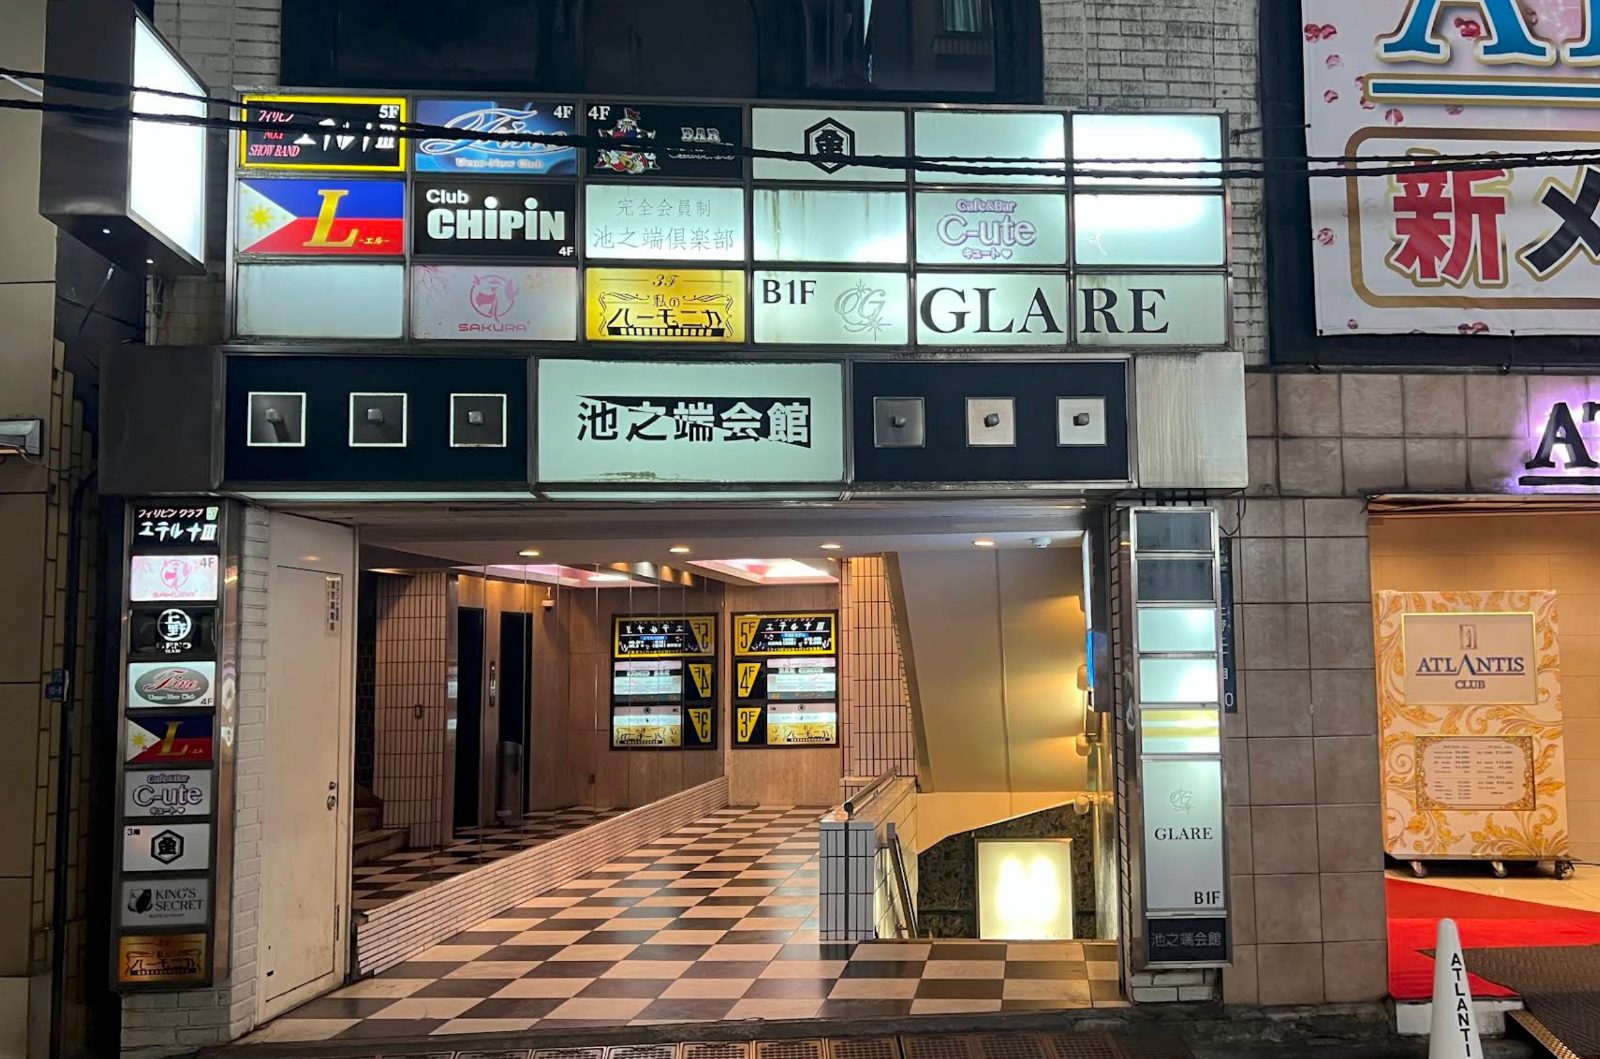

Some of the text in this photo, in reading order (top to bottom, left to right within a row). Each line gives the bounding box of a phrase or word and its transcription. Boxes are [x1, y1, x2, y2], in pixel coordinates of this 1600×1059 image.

[379, 105, 400, 119] 5F
[553, 105, 574, 119] 4F
[588, 106, 611, 121] 4F
[249, 144, 301, 157] SHOW BAND
[426, 189, 469, 204] Club
[616, 198, 711, 217] 完全会員制
[302, 189, 359, 248] L
[937, 214, 1036, 246] C-ute
[558, 246, 574, 257] 4F
[762, 279, 817, 305] B1F
[653, 294, 681, 308] 私の
[920, 286, 1169, 334] GLARE
[607, 308, 723, 329] ハーモニカ
[458, 323, 527, 332] SAKURA
[576, 400, 810, 444] 池之端会館
[1524, 401, 1600, 469] A
[200, 557, 214, 568] 4F
[1416, 653, 1524, 675] ATLANTIS
[740, 665, 756, 693] 4F
[1454, 680, 1486, 689] CLUB
[740, 710, 756, 739] 3F
[133, 784, 203, 807] C-ute
[1154, 827, 1213, 840] GLARE
[155, 887, 197, 900] KING'S
[1194, 891, 1220, 905] B1F
[155, 900, 204, 911] SECRET
[1150, 931, 1222, 947] 池之端会館
